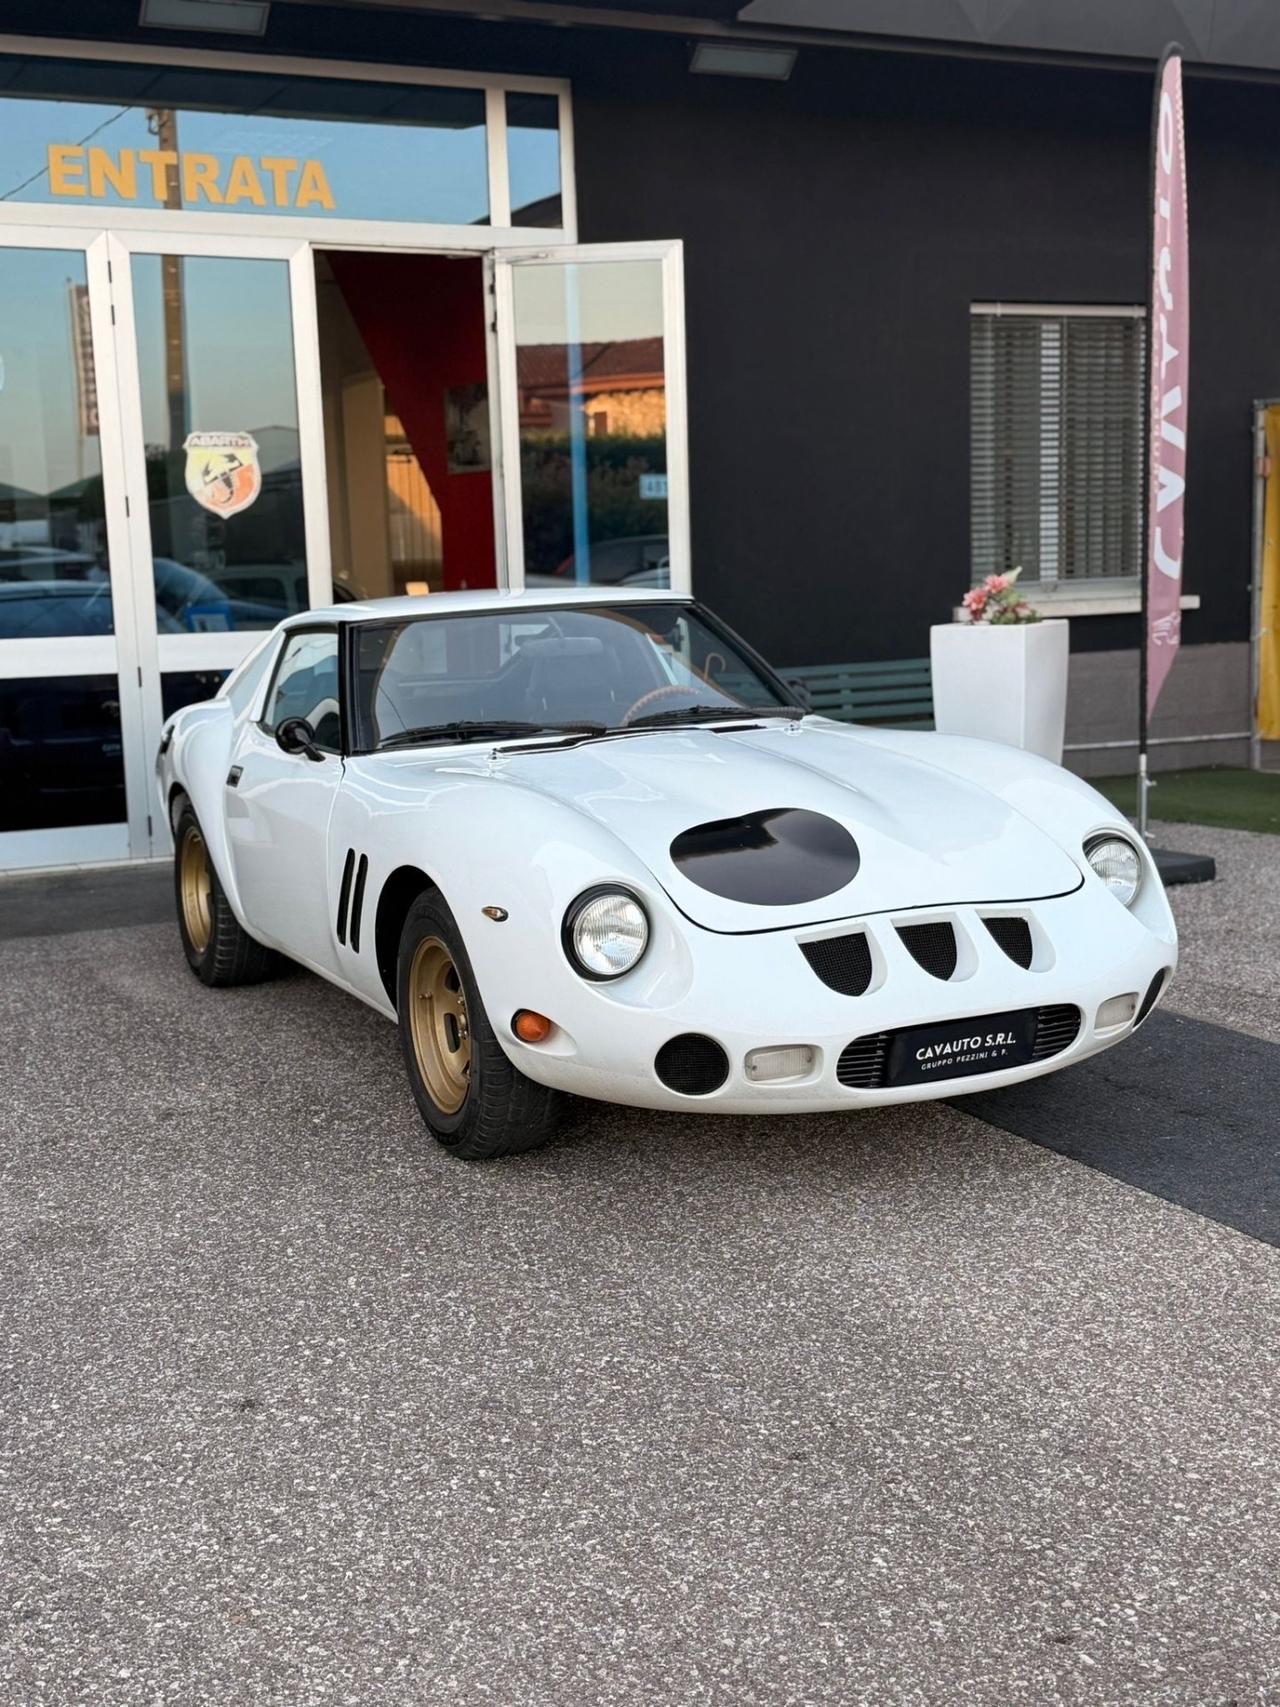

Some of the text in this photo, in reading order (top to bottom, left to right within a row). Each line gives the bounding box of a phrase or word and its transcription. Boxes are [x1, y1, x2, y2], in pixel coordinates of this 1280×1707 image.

[48, 144, 336, 210] ENTRATA
[915, 1032, 1016, 1060] CAVAUTO S.R.L.
[921, 1058, 953, 1071] GRUPPO
[956, 1051, 988, 1063] PEZZINI
